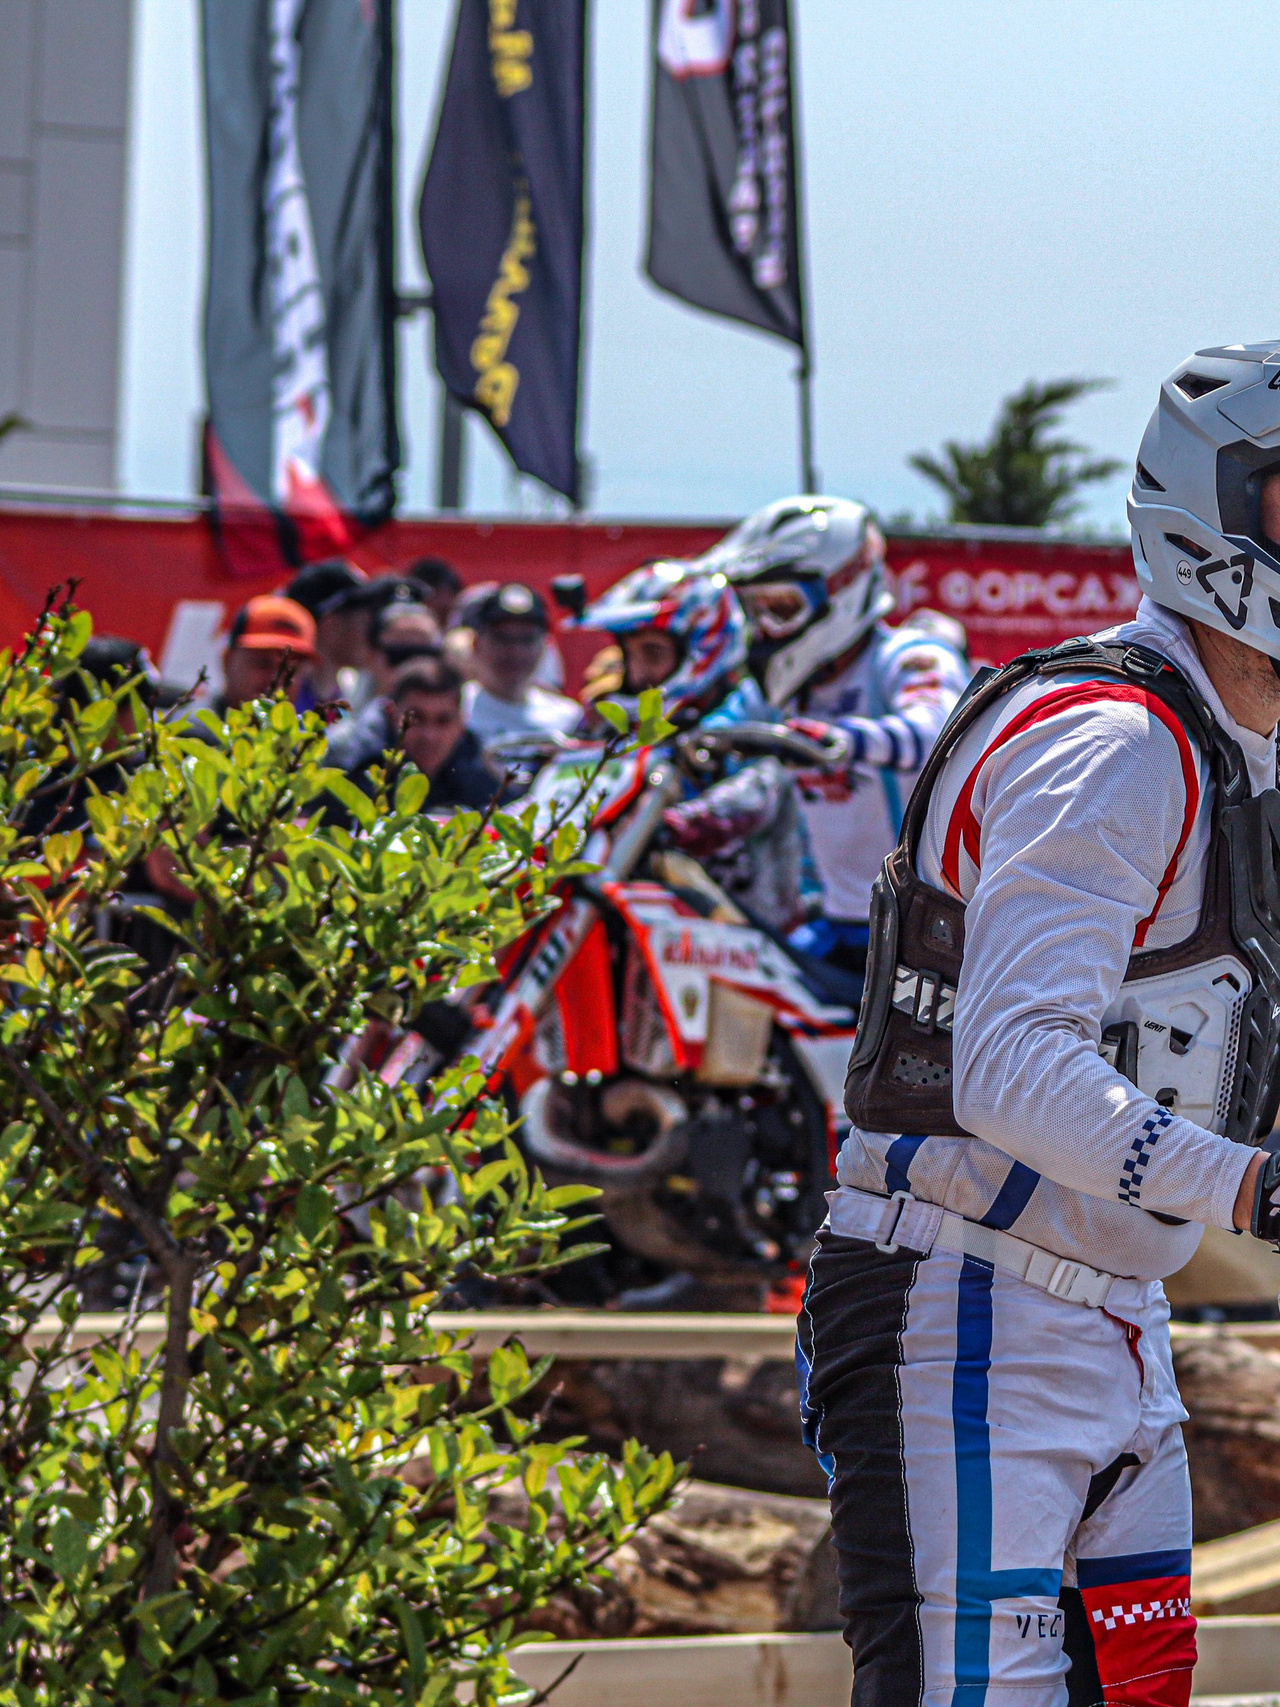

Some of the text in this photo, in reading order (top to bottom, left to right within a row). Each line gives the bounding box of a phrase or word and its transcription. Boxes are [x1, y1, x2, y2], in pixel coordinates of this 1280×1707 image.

[1178, 567, 1192, 579] 449
[1143, 1020, 1167, 1033] LEATT
[1016, 1614, 1066, 1639] VEC
